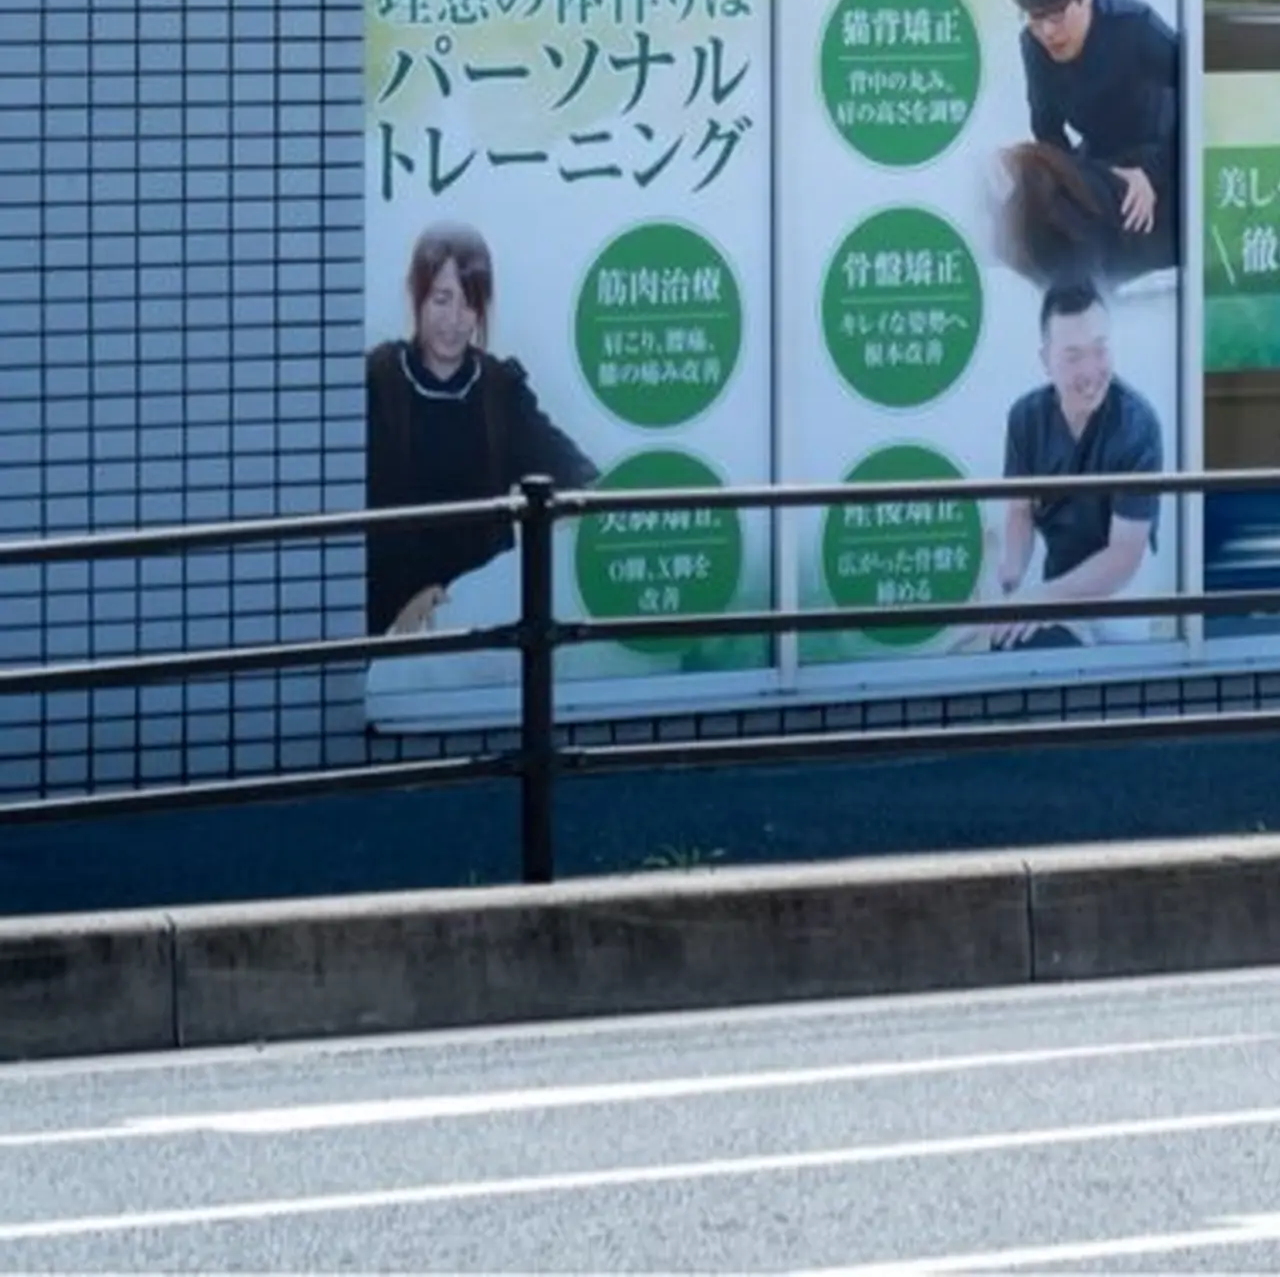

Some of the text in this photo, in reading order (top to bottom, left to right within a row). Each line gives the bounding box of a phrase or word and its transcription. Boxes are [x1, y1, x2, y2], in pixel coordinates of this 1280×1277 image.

[378, 30, 750, 114] パーソナル
[378, 116, 752, 201] トレーニング
